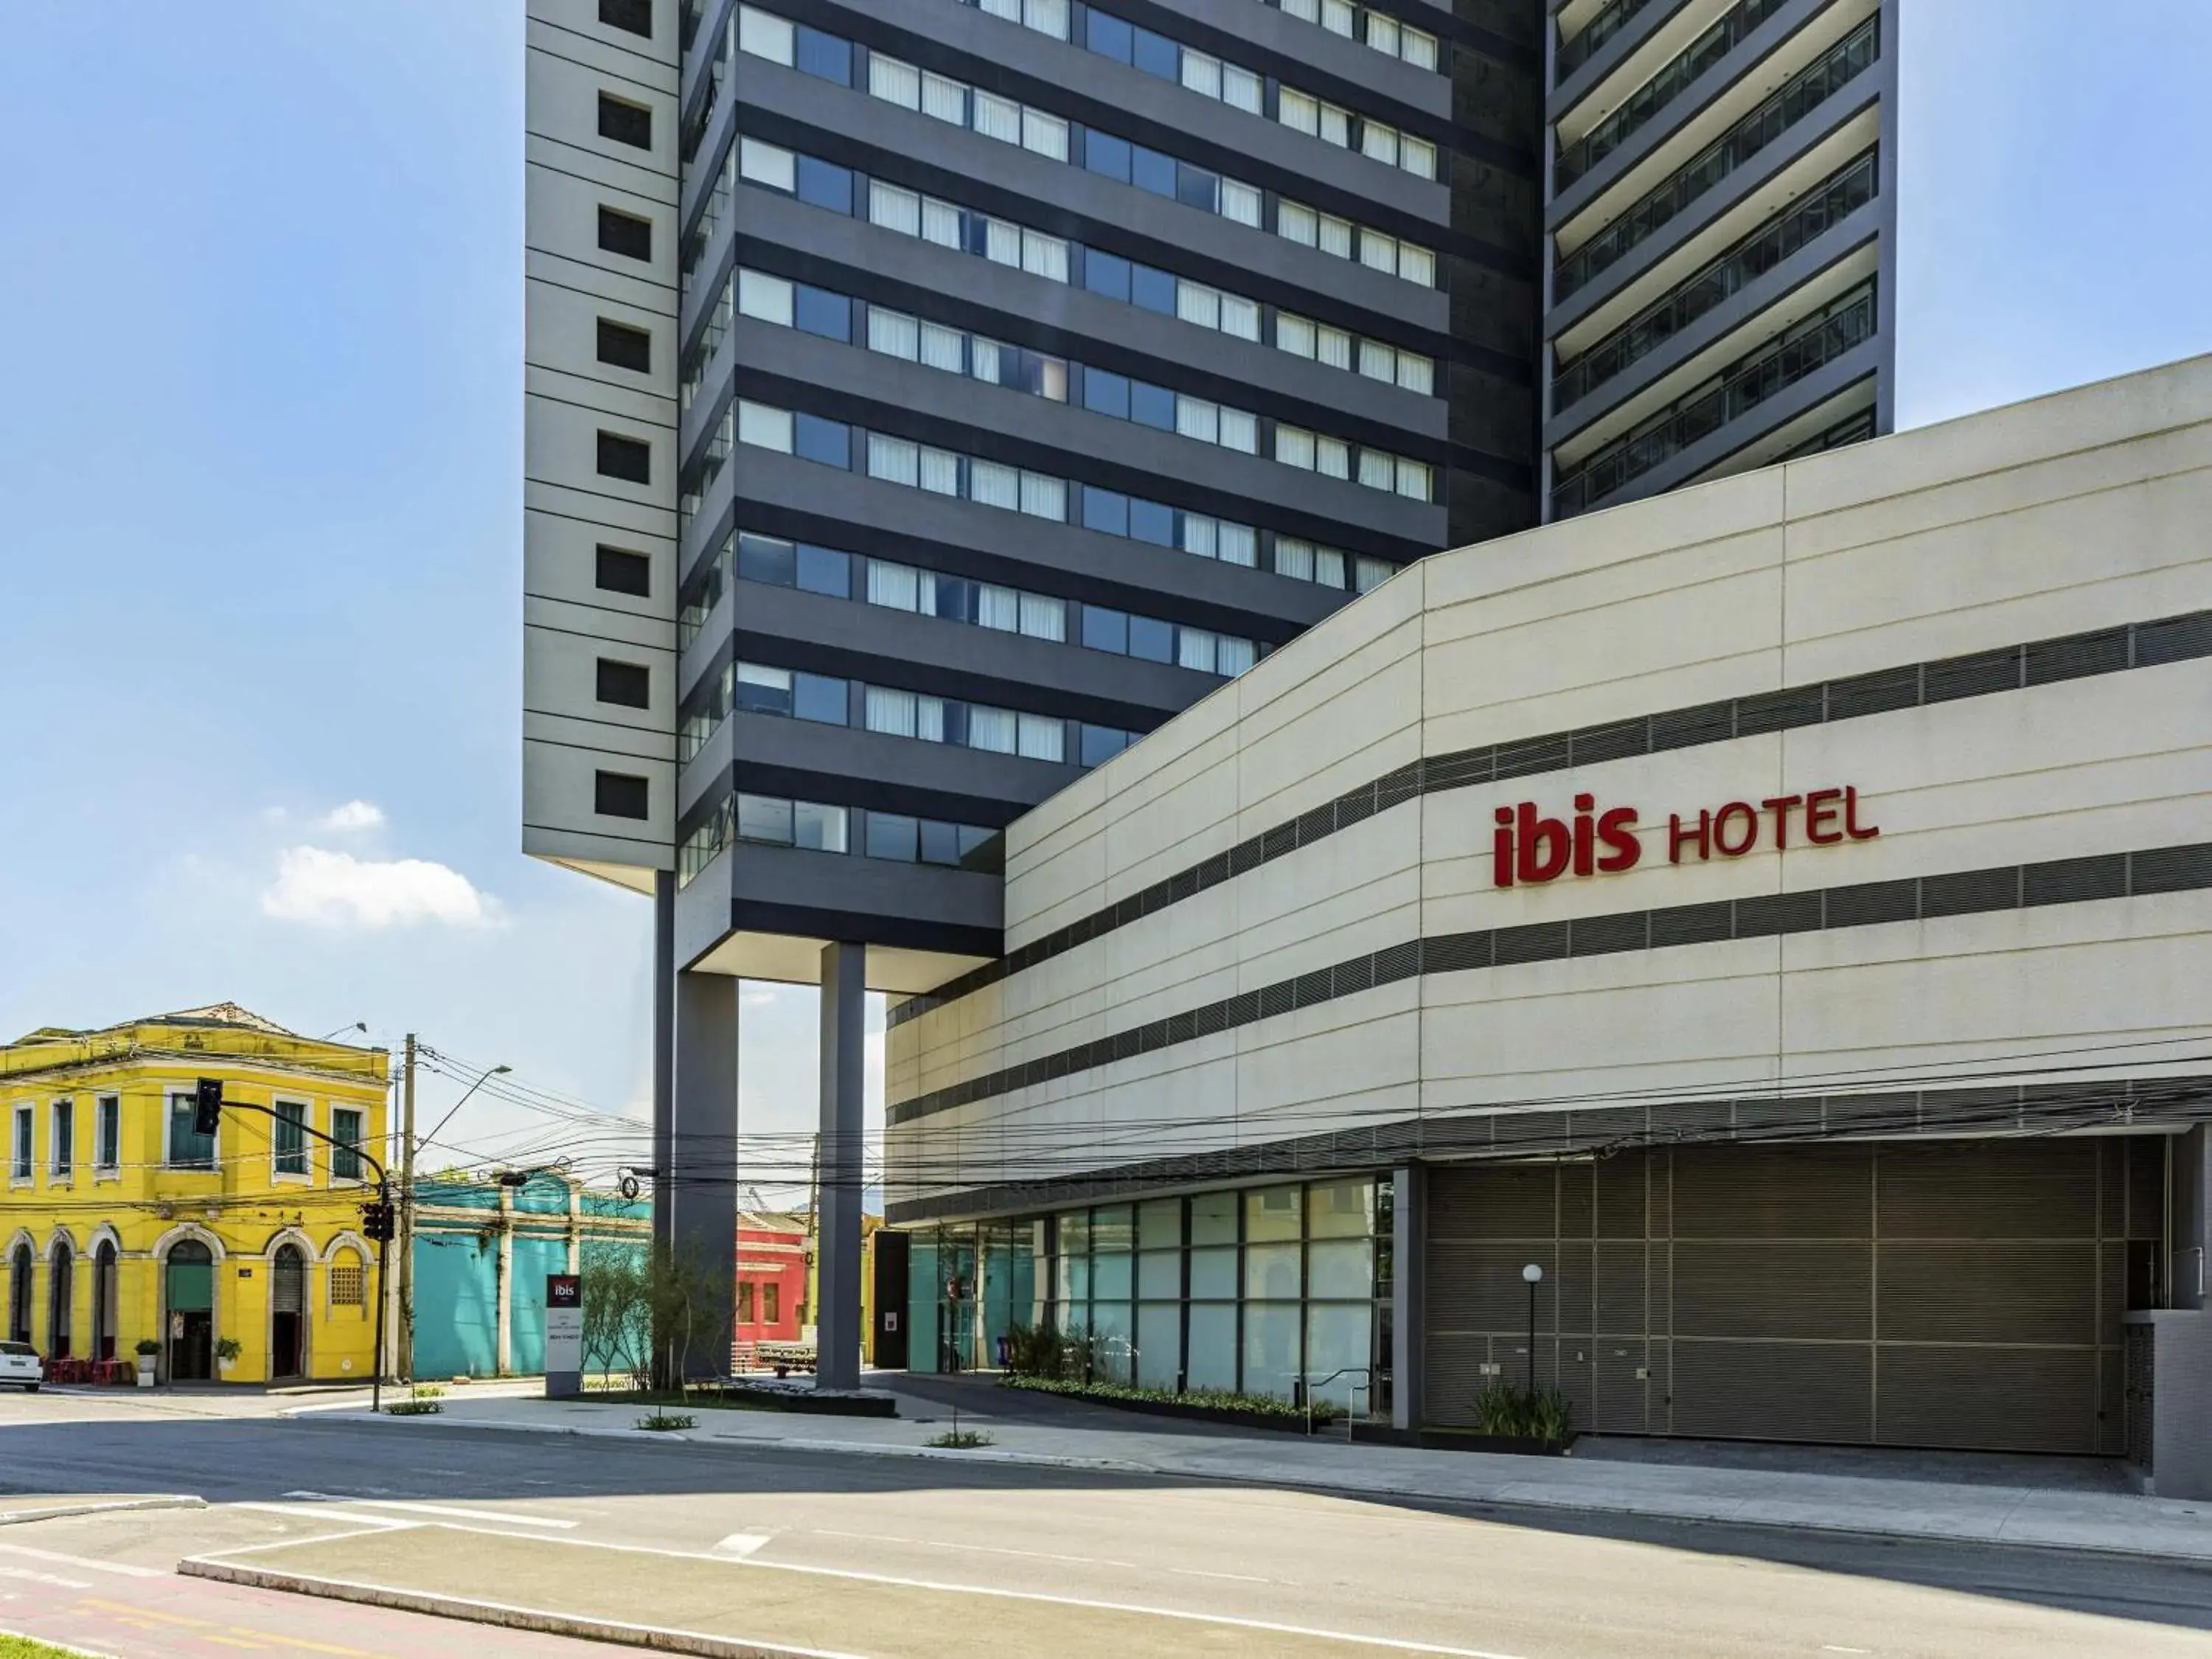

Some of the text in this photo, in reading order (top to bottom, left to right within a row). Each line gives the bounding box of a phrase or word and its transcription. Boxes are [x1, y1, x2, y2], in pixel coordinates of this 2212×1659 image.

[1494, 785, 1879, 888] ibis HOTEL
[554, 1284, 575, 1295] ibis
